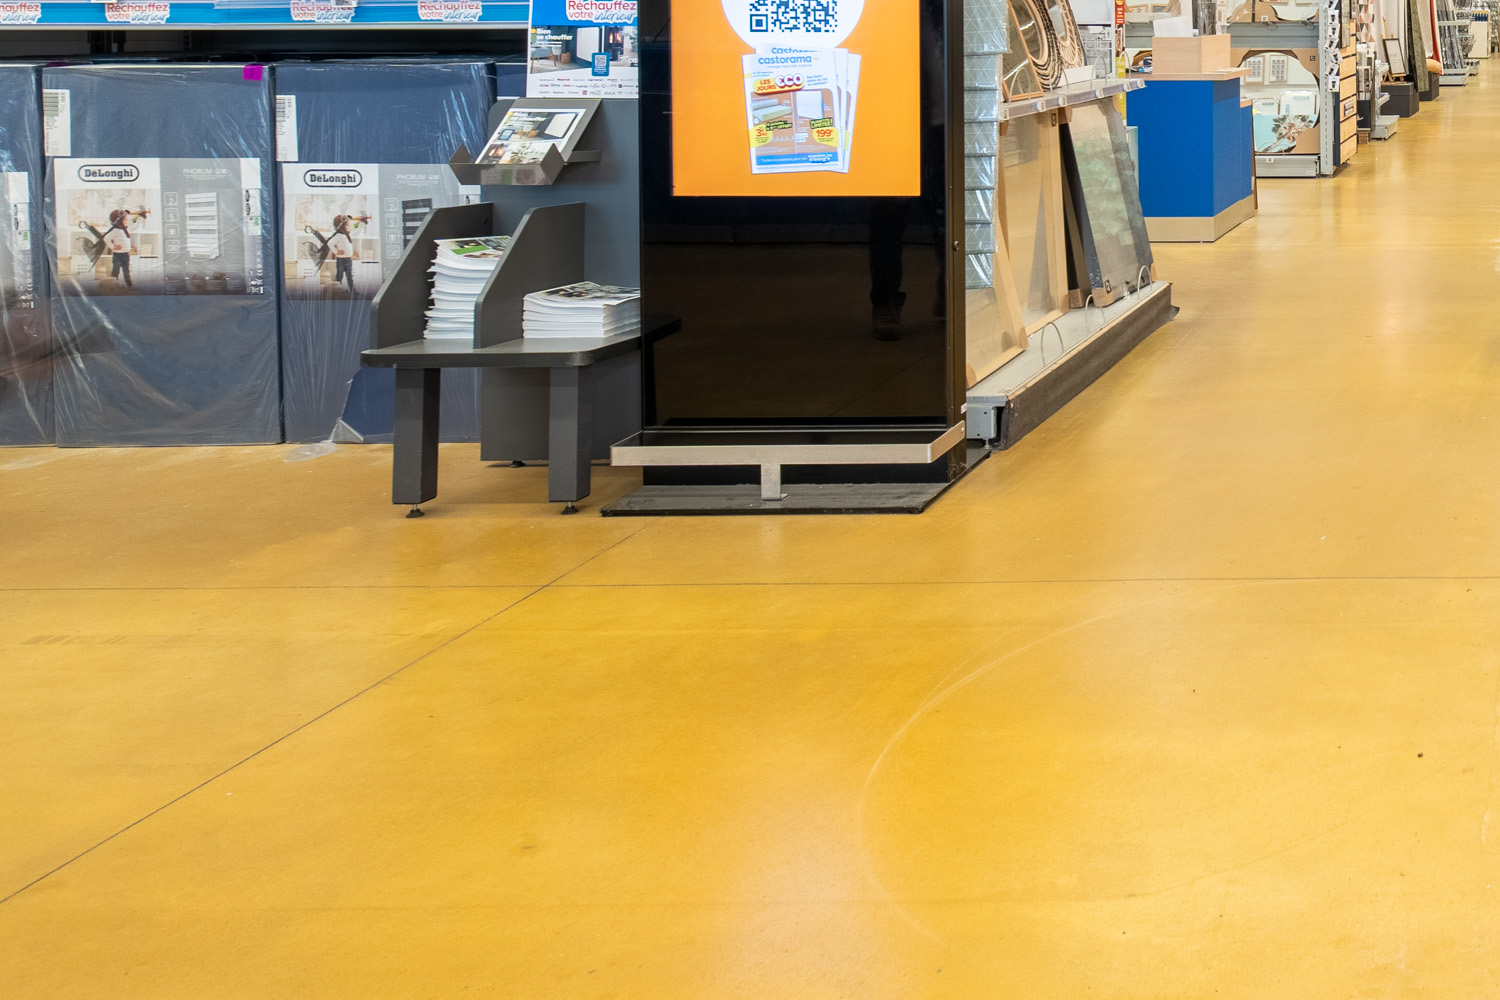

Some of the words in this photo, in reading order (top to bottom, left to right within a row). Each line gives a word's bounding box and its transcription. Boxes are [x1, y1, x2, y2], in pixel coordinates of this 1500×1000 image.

[107, 2, 168, 12] Réchauffez
[419, 0, 480, 10] Réchauffez
[568, 0, 637, 11] Réchauffez
[293, 11, 316, 19] votre
[569, 11, 593, 19] votre
[758, 55, 812, 65] castorama
